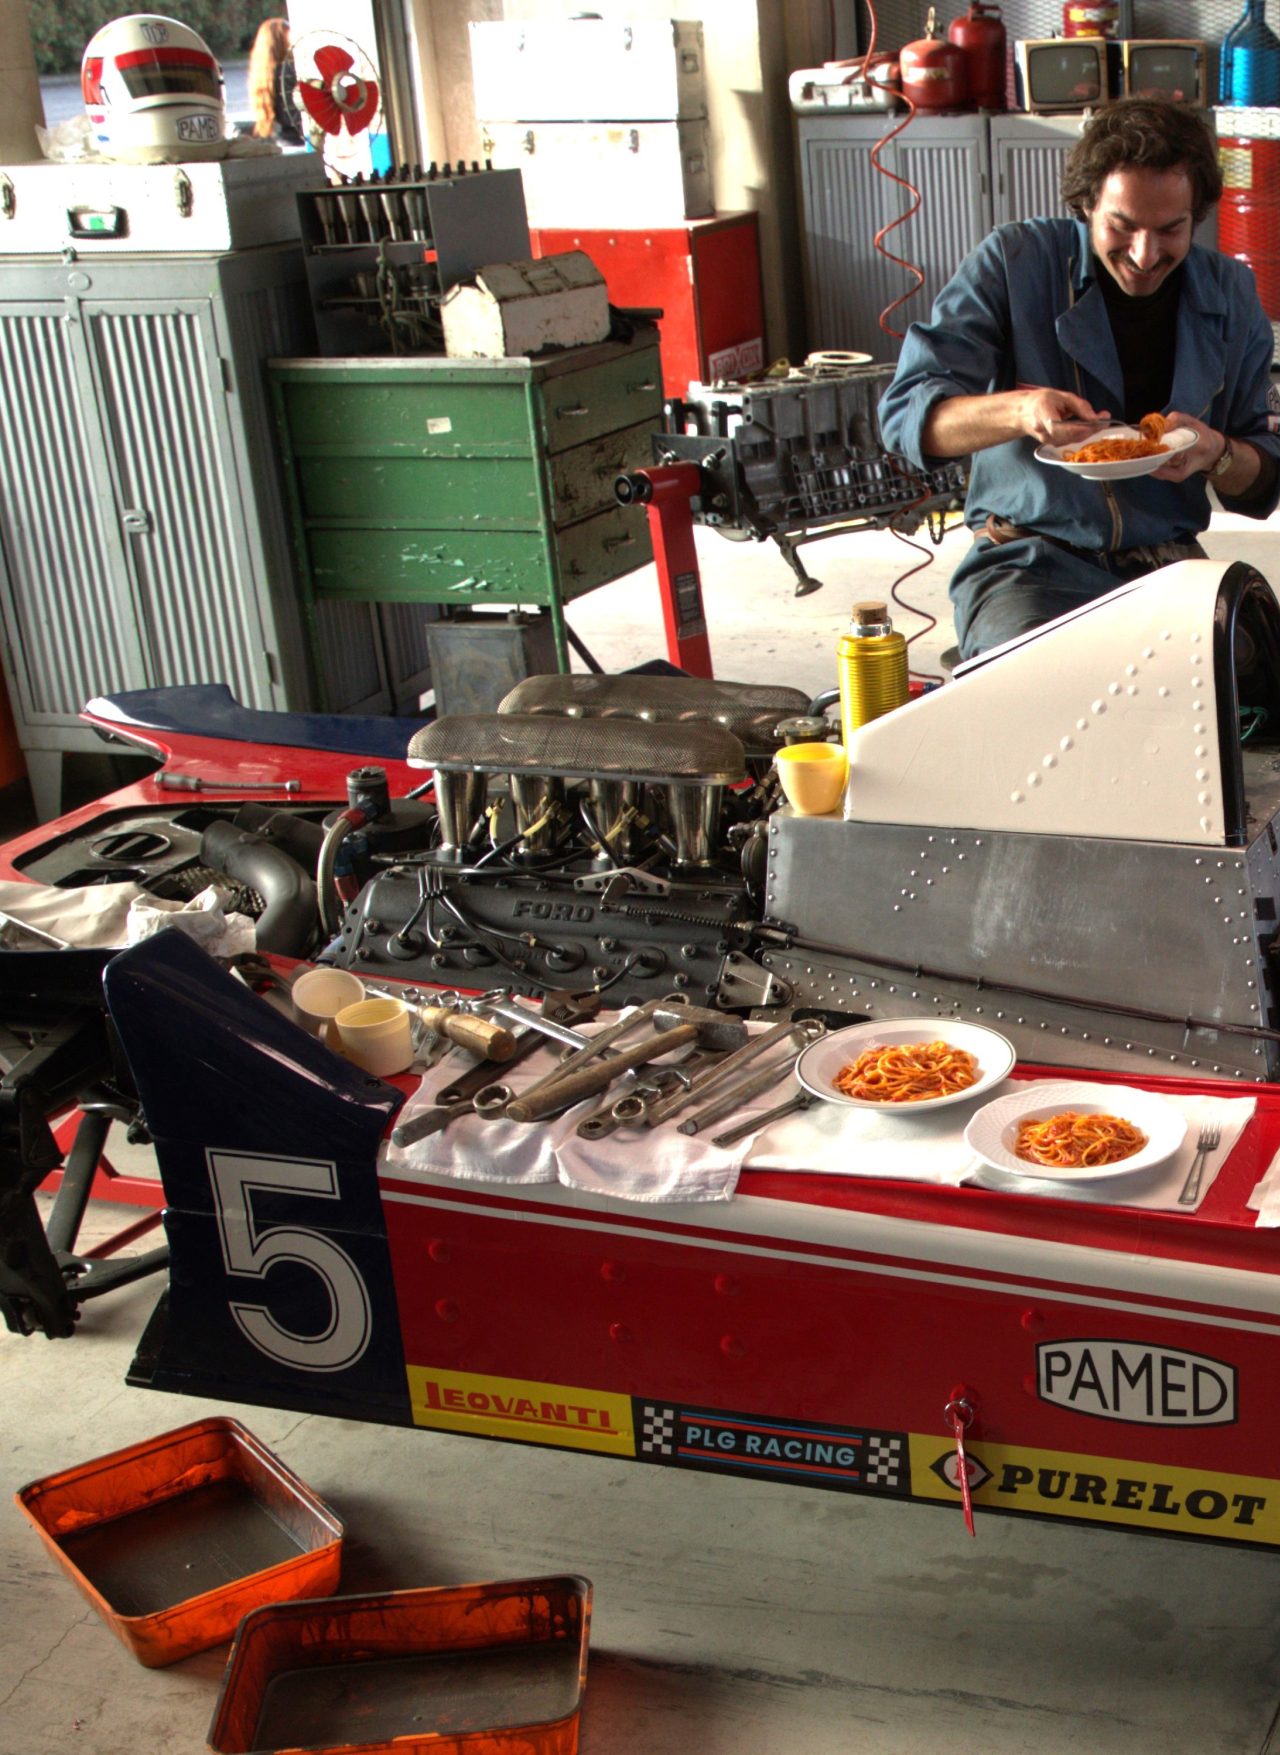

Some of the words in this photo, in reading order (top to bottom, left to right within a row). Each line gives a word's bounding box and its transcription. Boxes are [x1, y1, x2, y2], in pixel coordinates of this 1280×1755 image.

[512, 900, 594, 923] FORD
[205, 1147, 373, 1373] 5
[424, 1381, 614, 1430] LEOVANTI
[1044, 1347, 1228, 1418] PAMED
[685, 1425, 736, 1450] PLG
[745, 1434, 856, 1466] RACING
[997, 1463, 1267, 1527] PURELOT
